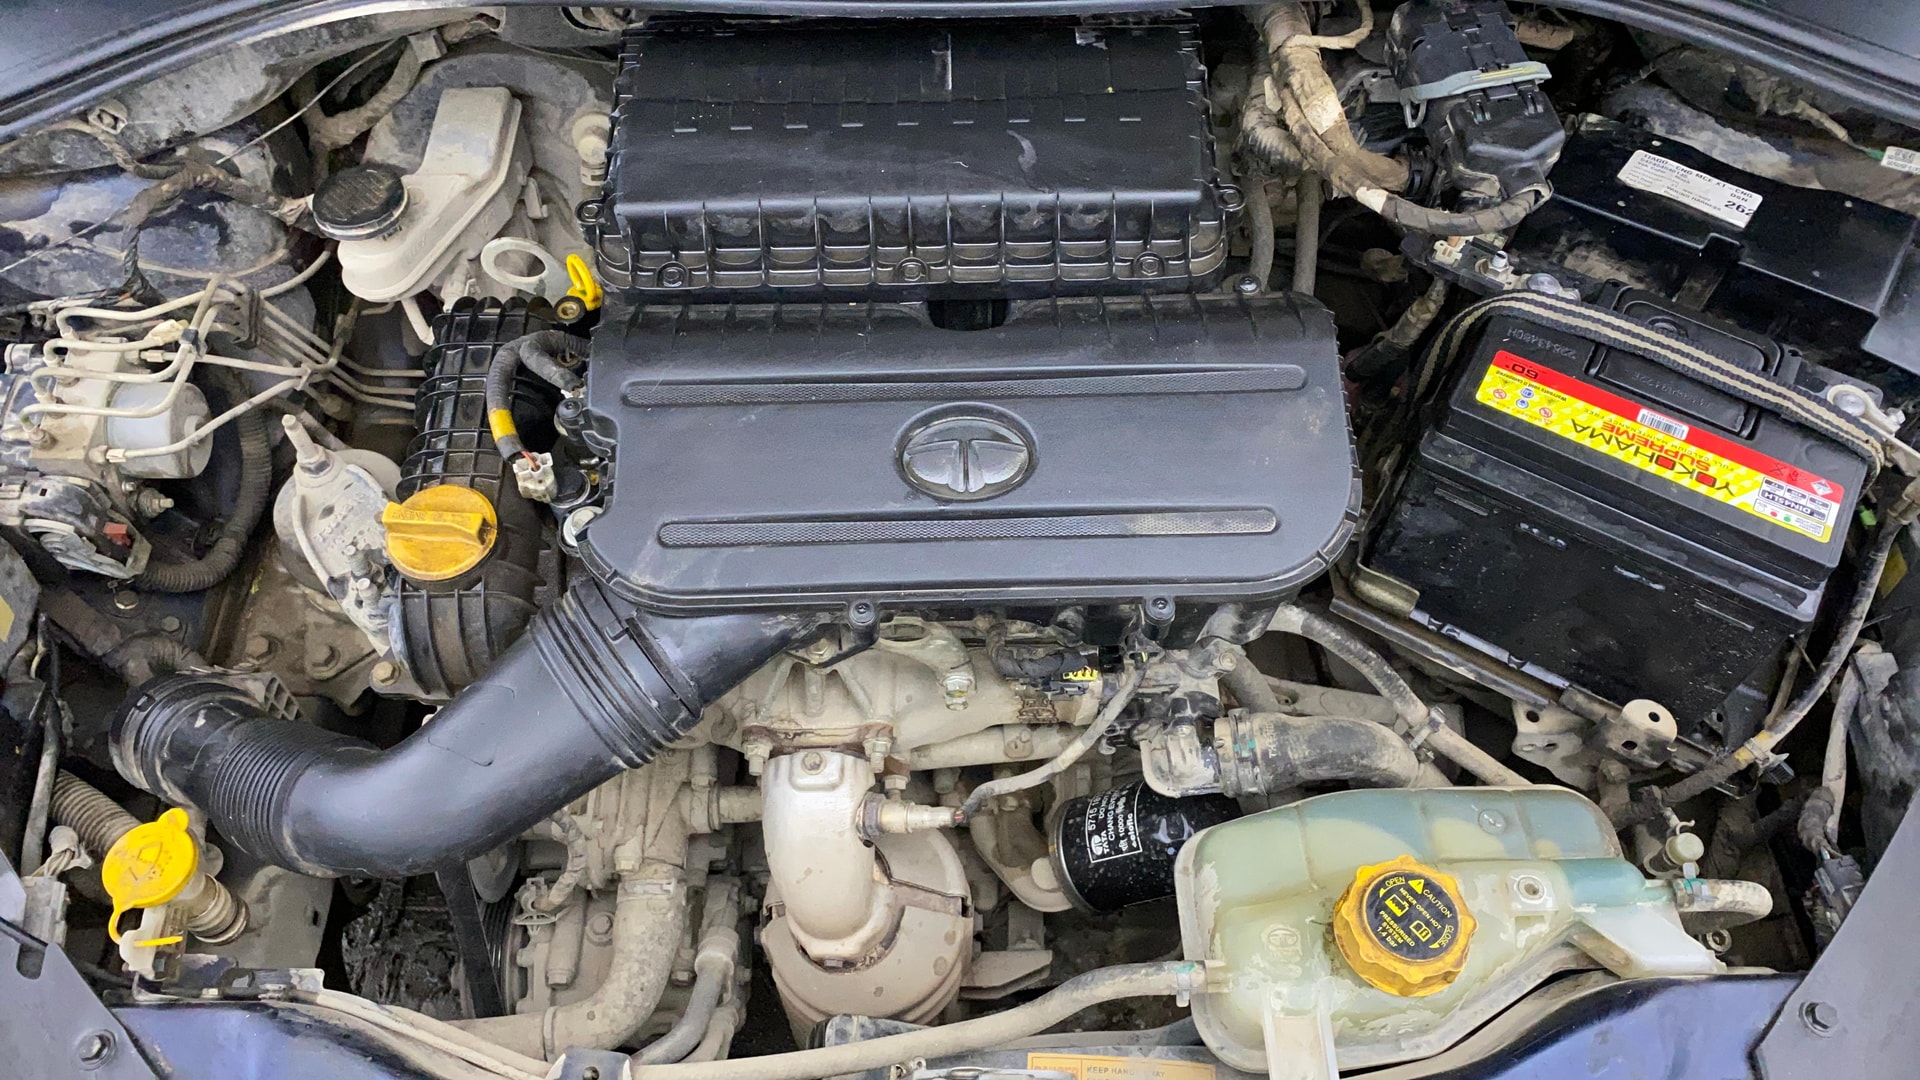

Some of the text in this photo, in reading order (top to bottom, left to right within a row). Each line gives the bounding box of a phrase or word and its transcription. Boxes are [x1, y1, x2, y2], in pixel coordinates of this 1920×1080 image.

[1571, 418, 1735, 497] YOKOHAMA
[1601, 421, 1711, 472] SUPREME
[1107, 811, 1115, 841] CHANG
[1101, 830, 1110, 854] TATA
[1385, 876, 1405, 886] OPEN
[1399, 887, 1442, 930] NEVER OPEN HOT
[1423, 889, 1452, 918] CAUTION
[1380, 910, 1415, 946] PRESSURISED
[1382, 921, 1404, 944] SYSTEM
[1386, 936, 1398, 947] bar
[1086, 1065, 1109, 1074] KEEP
